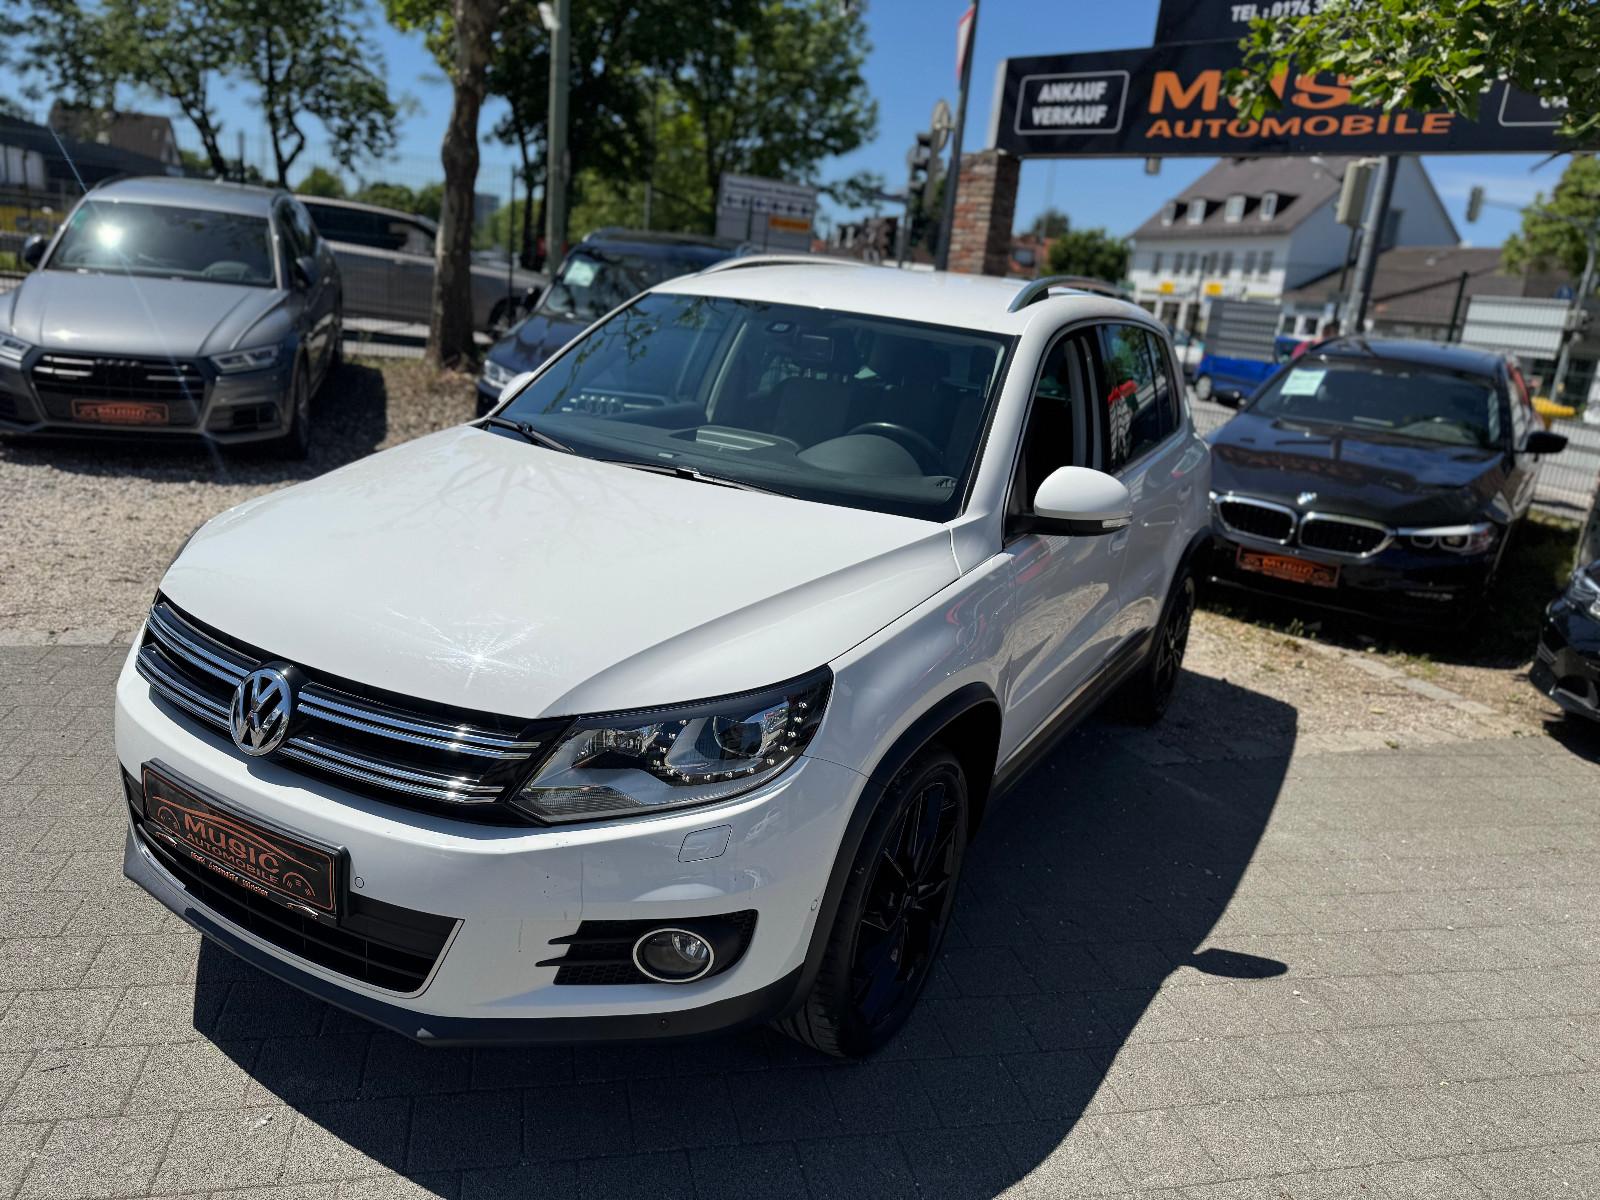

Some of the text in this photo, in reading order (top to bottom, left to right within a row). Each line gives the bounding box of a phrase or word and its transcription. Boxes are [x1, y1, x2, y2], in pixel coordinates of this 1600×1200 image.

[1037, 81, 1108, 103] ANKAUF
[1031, 104, 1108, 126] VERKAUF
[1145, 112, 1456, 138] AUTOMOBILE
[186, 833, 279, 883] AUTOMOBILE
